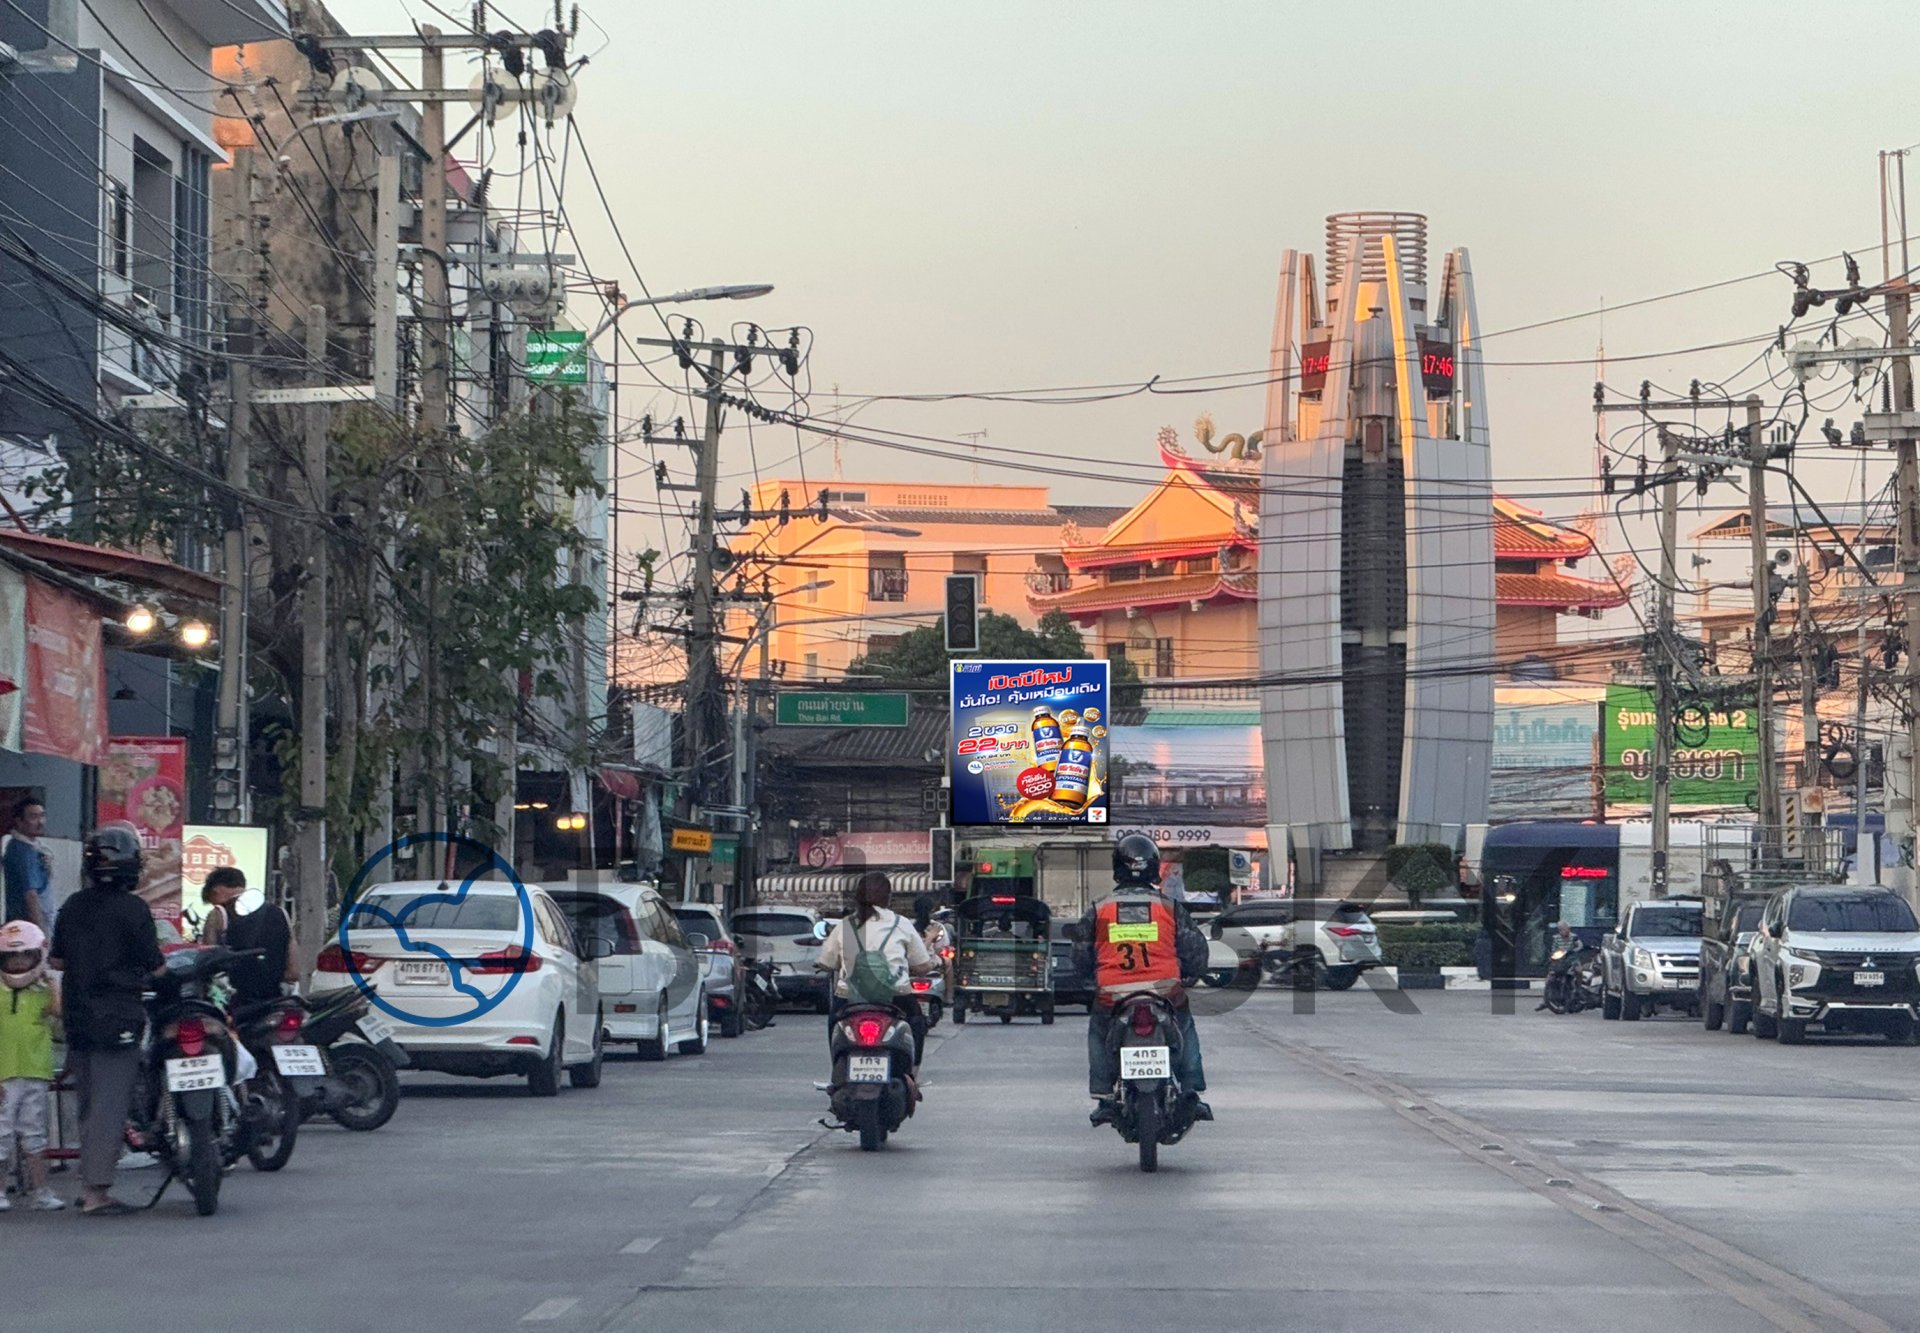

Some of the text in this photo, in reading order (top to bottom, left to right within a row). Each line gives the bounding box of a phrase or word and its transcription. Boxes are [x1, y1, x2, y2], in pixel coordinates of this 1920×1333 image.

[1423, 354, 1454, 377] 17:46
[988, 667, 1073, 691] เปิดปีใหม่
[1008, 682, 1101, 705] คุ้มเหมือนเดิม
[968, 727, 982, 738] 2
[957, 737, 998, 755] 22
[1000, 740, 1030, 751] บาท
[1024, 782, 1053, 794] 1000
[1177, 829, 1211, 842] 9999
[1117, 942, 1150, 970] 31
[1129, 1068, 1162, 1076] 7600
